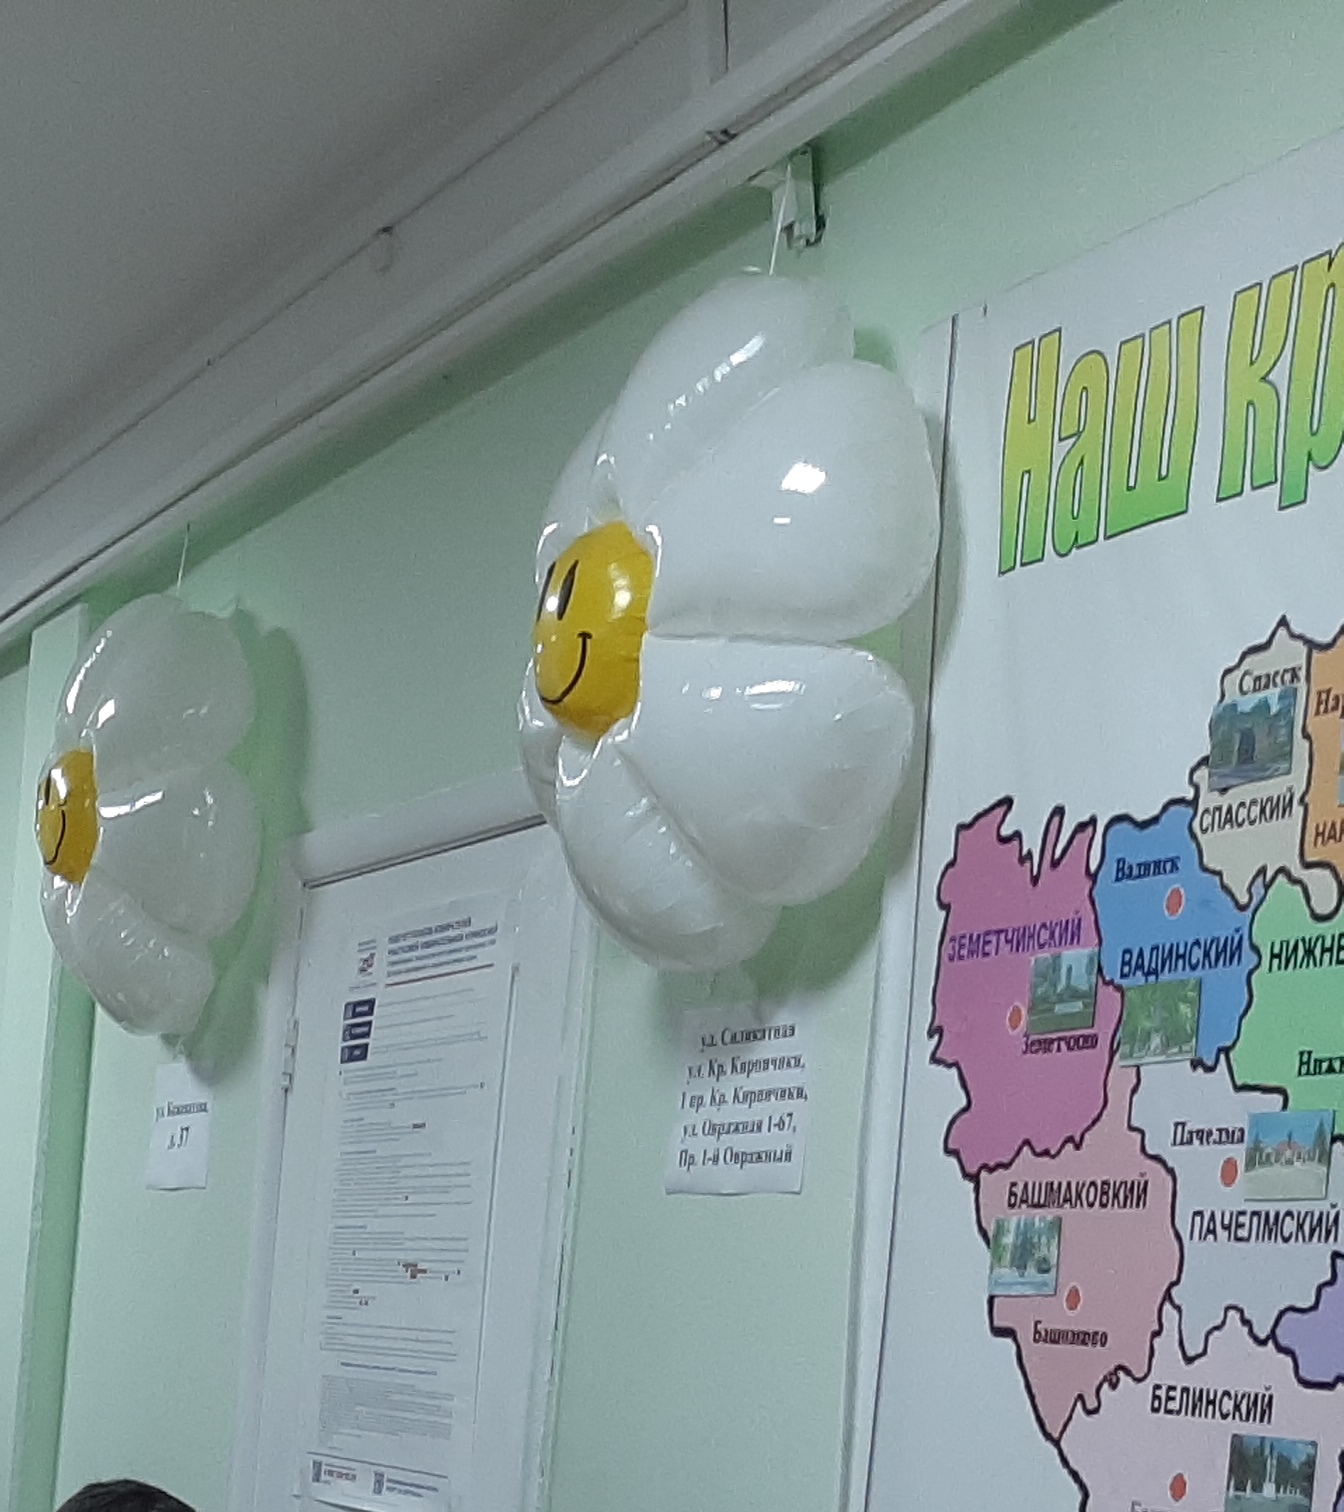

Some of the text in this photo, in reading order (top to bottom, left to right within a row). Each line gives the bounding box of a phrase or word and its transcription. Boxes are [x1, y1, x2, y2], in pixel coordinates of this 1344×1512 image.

[999, 306, 1205, 577] Наш
[1238, 666, 1302, 695] Спасск
[1199, 786, 1295, 835] СПАССКИЙ
[1113, 855, 1181, 882] Вадинск
[947, 910, 1082, 962] ЗЕМЕТЧИНСКИЙ
[1119, 926, 1244, 983] ВАДИНСКИЙ
[1171, 1120, 1245, 1147] Пачелма
[1007, 1171, 1149, 1210] БАШМАКОВКИЙ
[1189, 1202, 1341, 1244] ПАЧЕЛМСКИЙ
[1150, 1384, 1274, 1425] БЕЛИНСКИЙ
